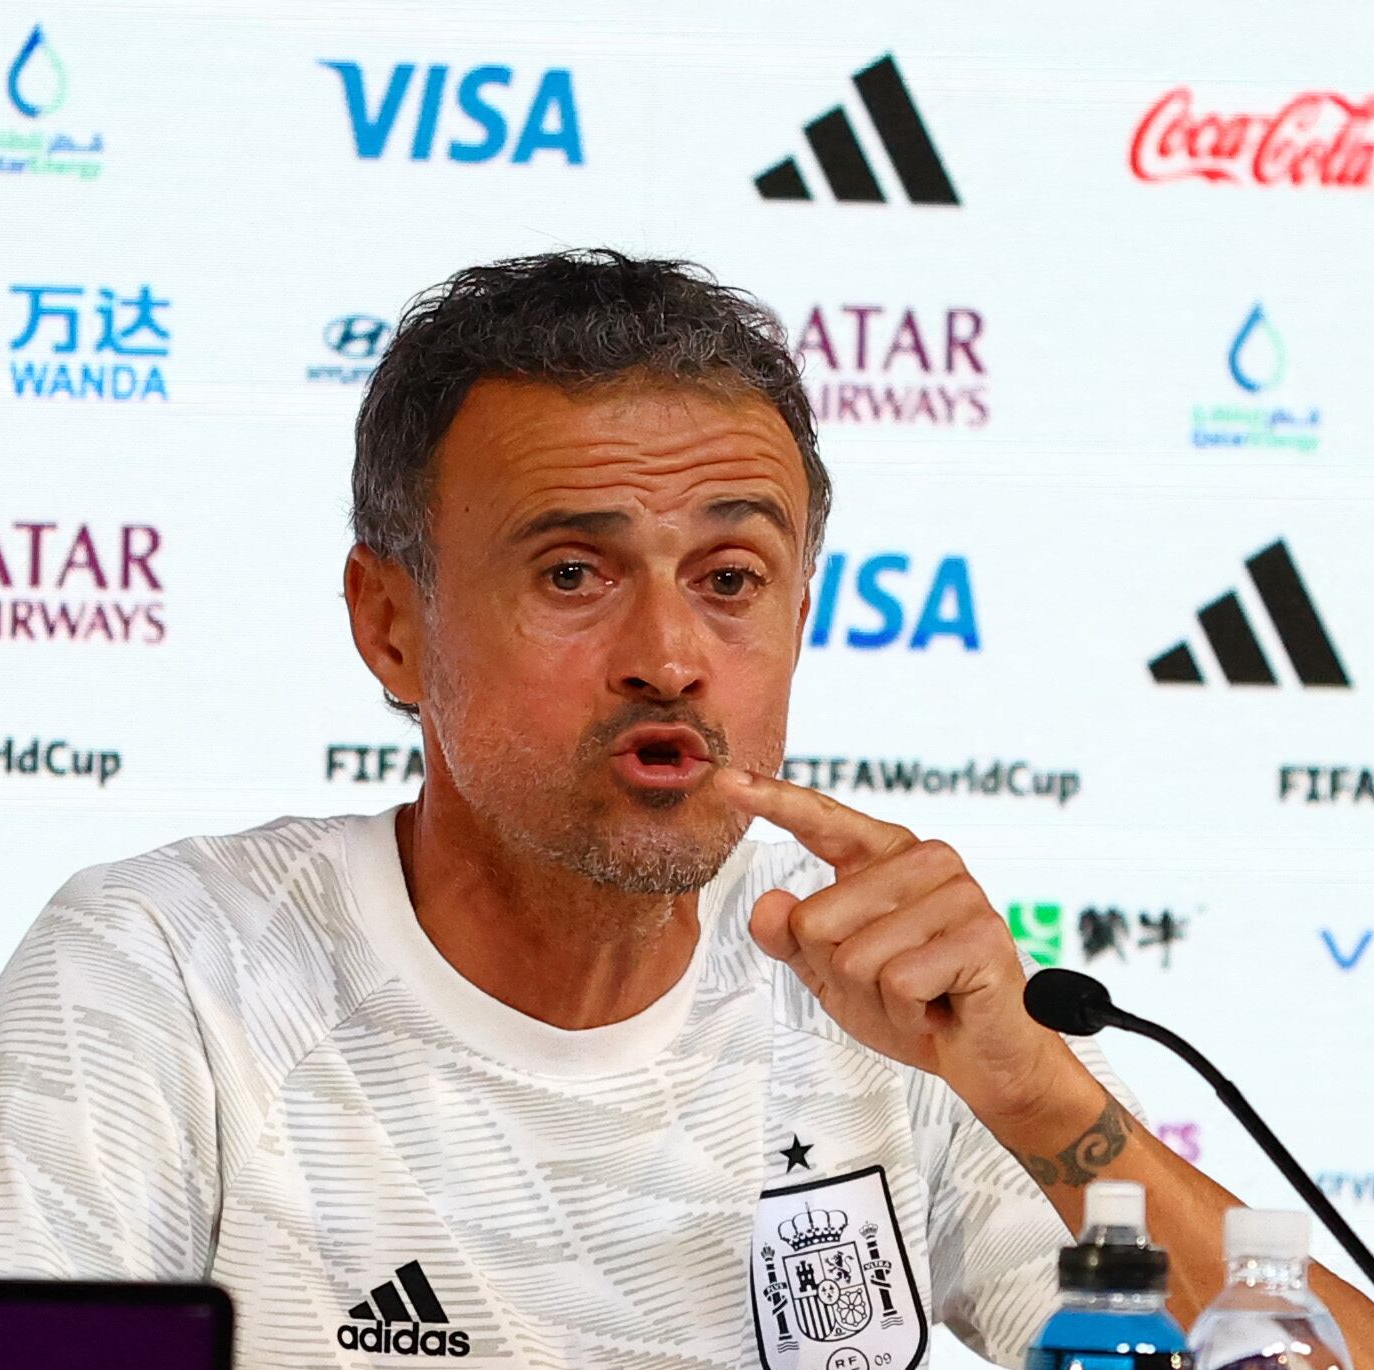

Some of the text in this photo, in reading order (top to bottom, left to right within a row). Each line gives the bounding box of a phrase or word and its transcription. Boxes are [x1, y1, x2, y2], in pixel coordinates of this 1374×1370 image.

[320, 60, 585, 166] VISA
[10, 285, 170, 357] 万达
[796, 303, 988, 376] ATAR
[10, 362, 167, 400] WANDA
[806, 382, 991, 430] IRWAYS
[809, 552, 982, 652] ISA
[327, 744, 422, 783] FIFA
[782, 757, 1082, 807] FIFAWorldCup
[337, 1322, 471, 1357] adidas
